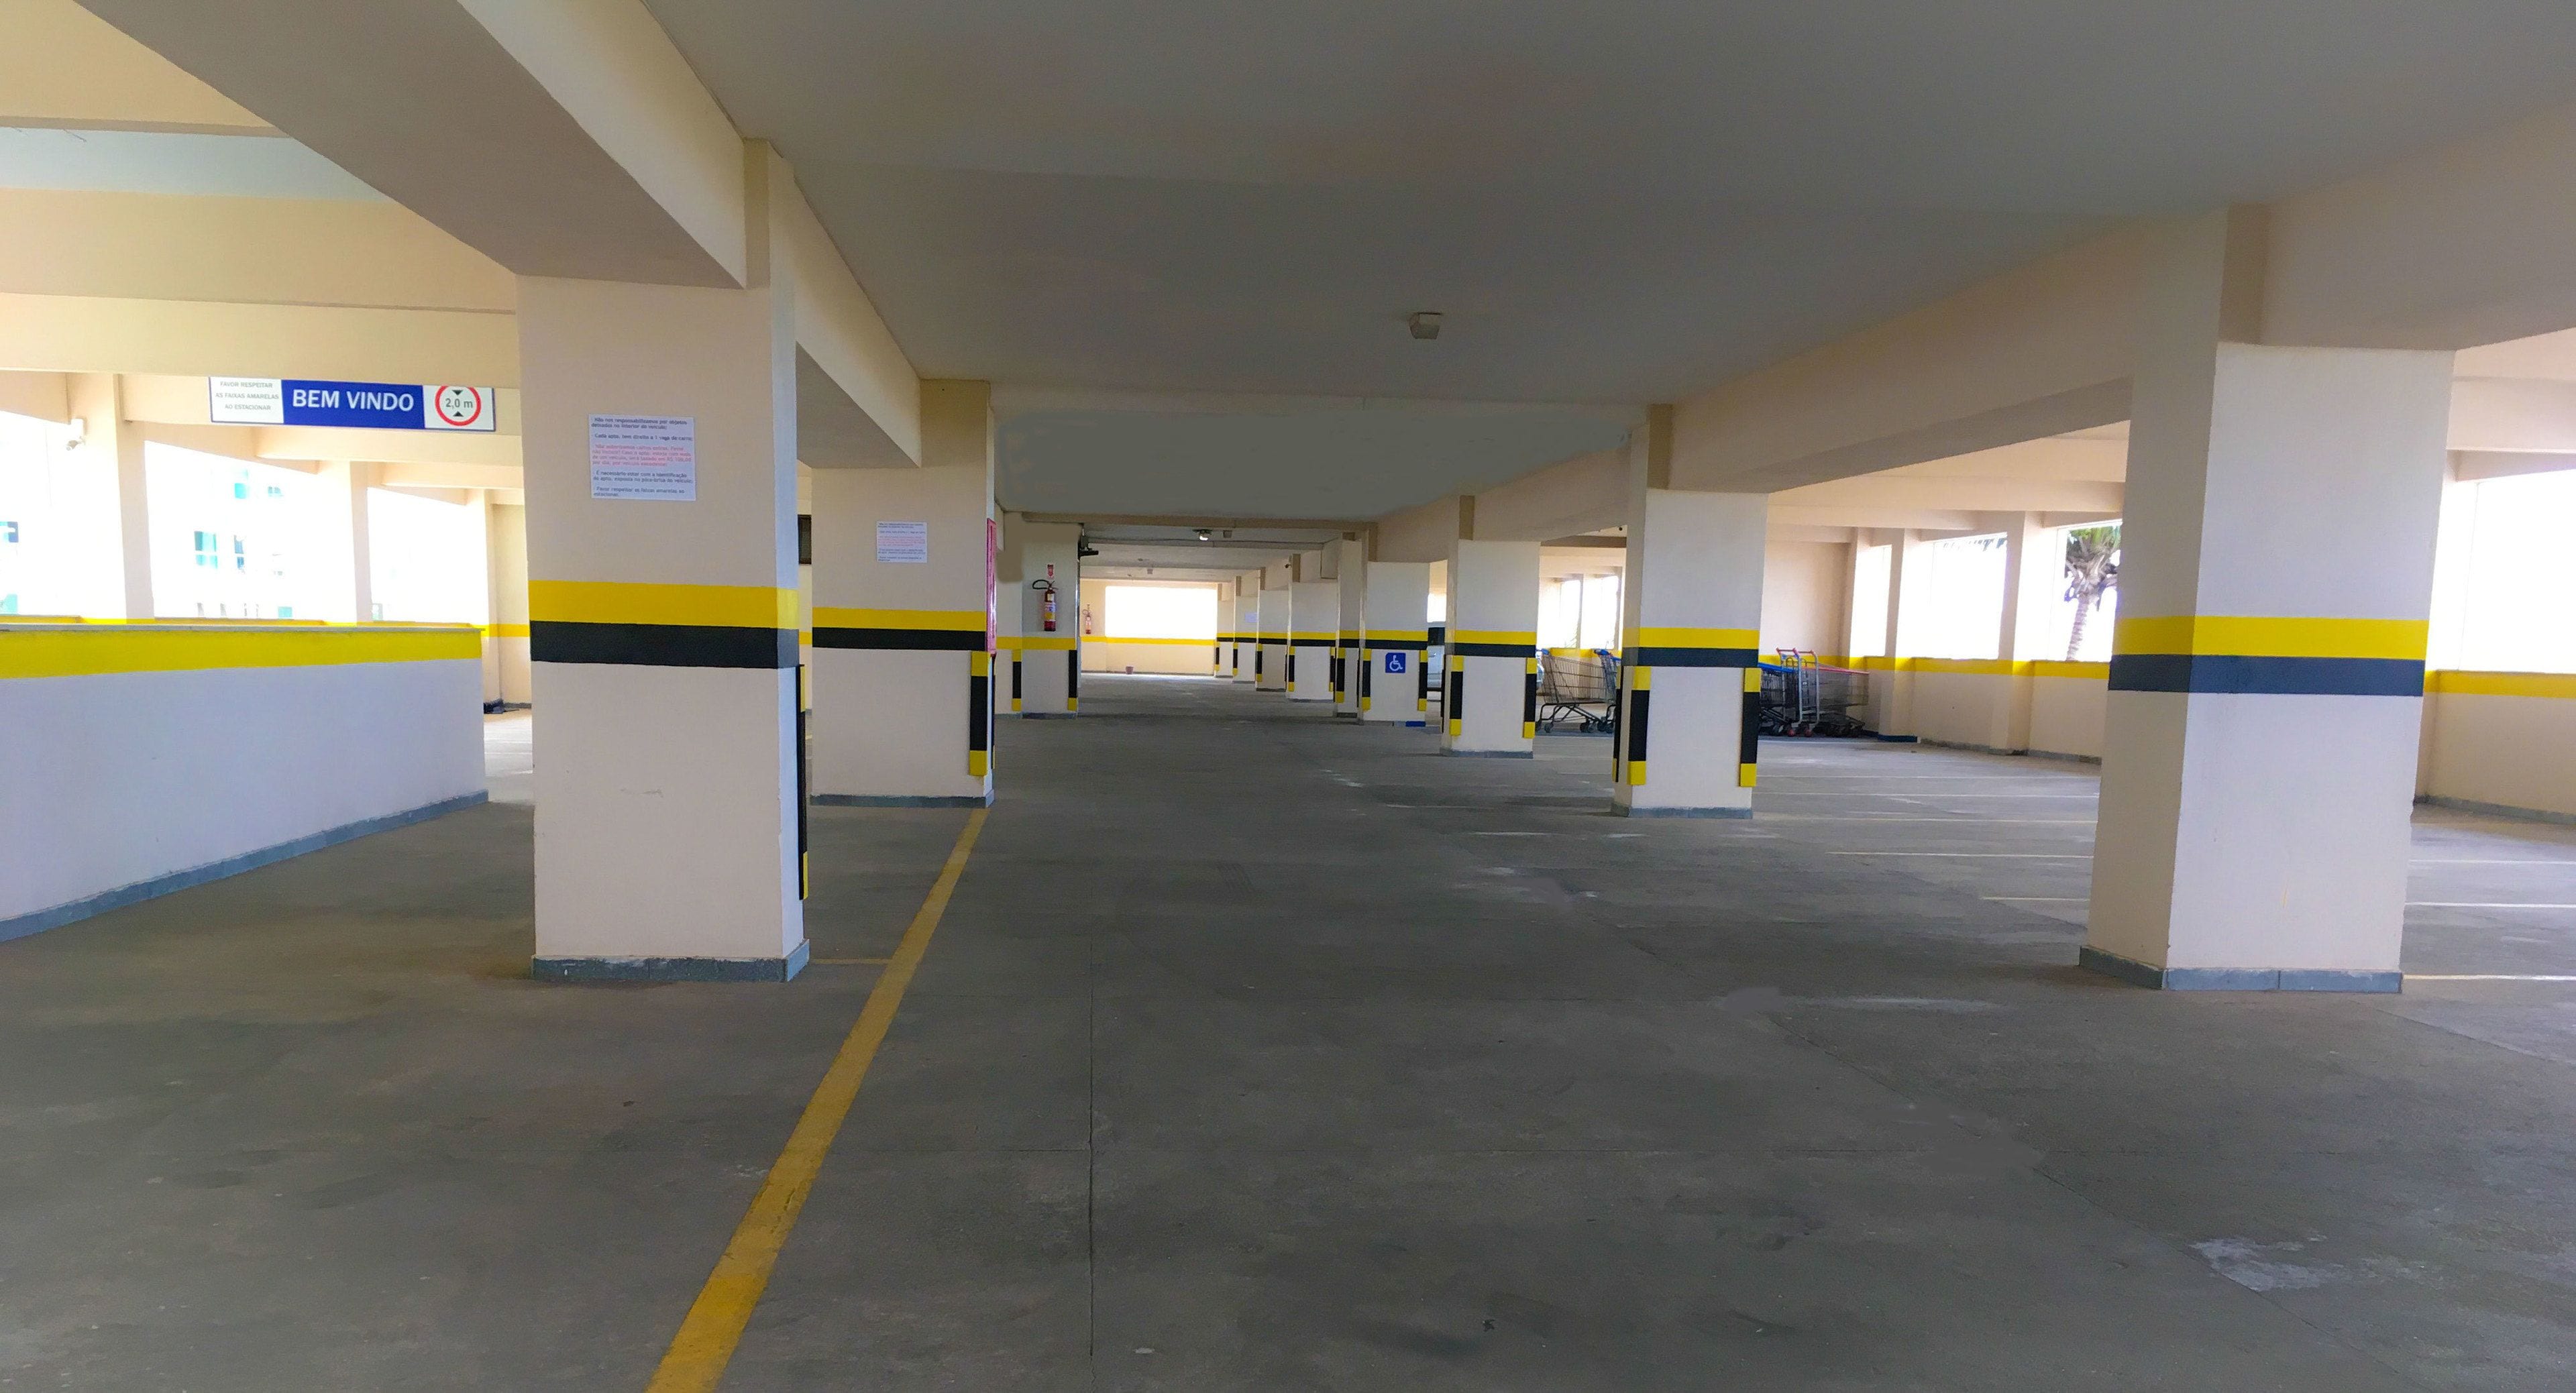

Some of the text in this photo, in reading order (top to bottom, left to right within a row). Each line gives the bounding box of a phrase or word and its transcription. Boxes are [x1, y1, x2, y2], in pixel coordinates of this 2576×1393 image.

[292, 389, 414, 411] BEM VINDO
[445, 398, 460, 409] 2,0
